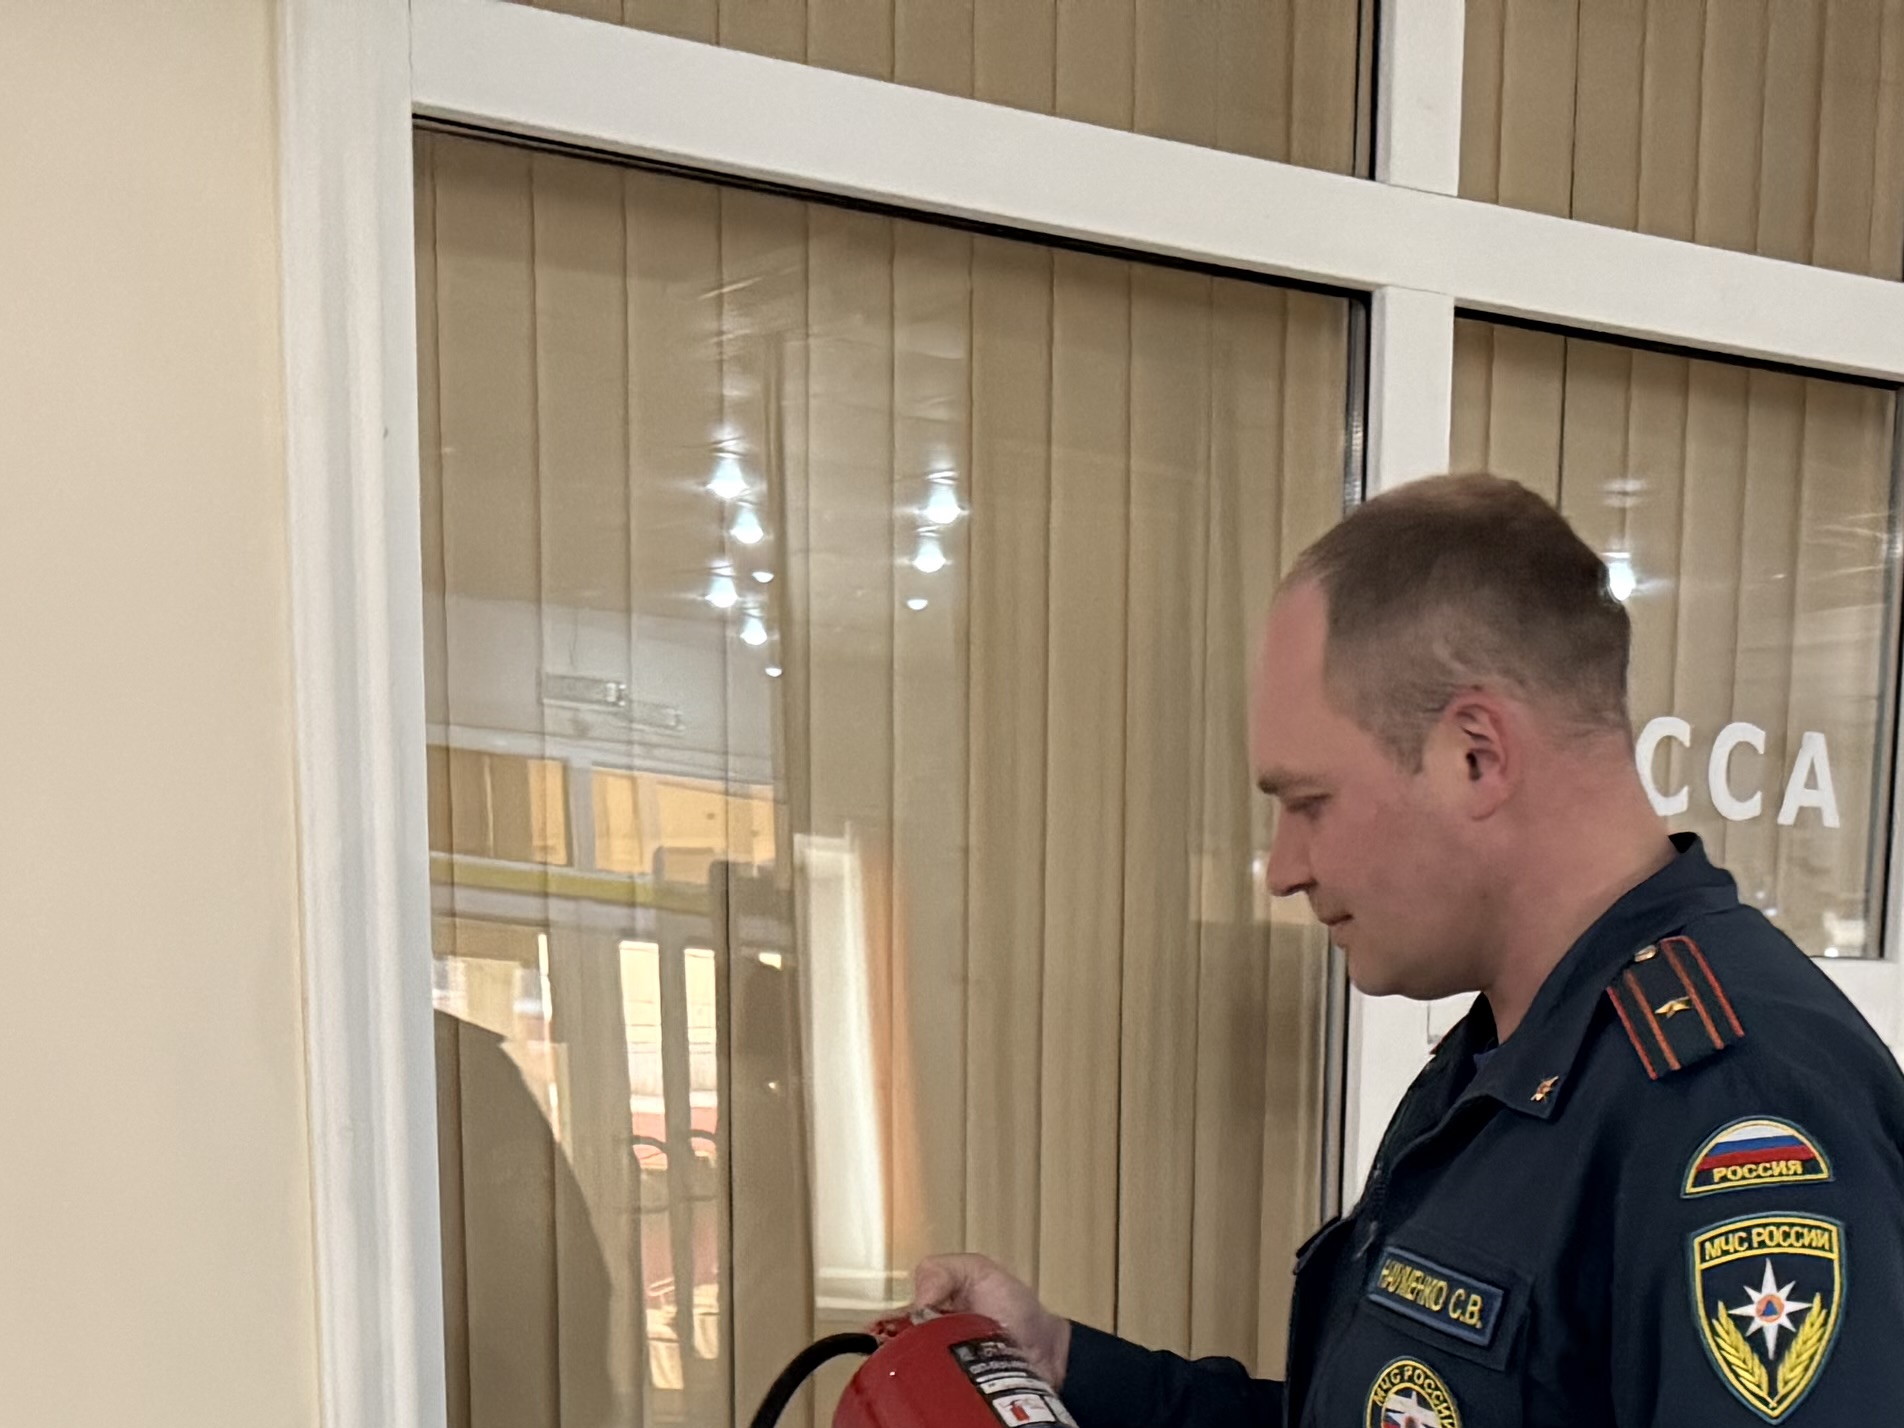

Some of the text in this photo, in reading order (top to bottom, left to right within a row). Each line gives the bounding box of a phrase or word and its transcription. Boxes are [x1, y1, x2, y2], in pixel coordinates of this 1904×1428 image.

[1636, 716, 1840, 828] ССА
[1713, 1160, 1803, 1182] РОССИЯ
[1705, 1226, 1830, 1260] МЧС РОССИИ
[1449, 1288, 1483, 1329] С.В.
[1373, 1368, 1401, 1406] МЧС
